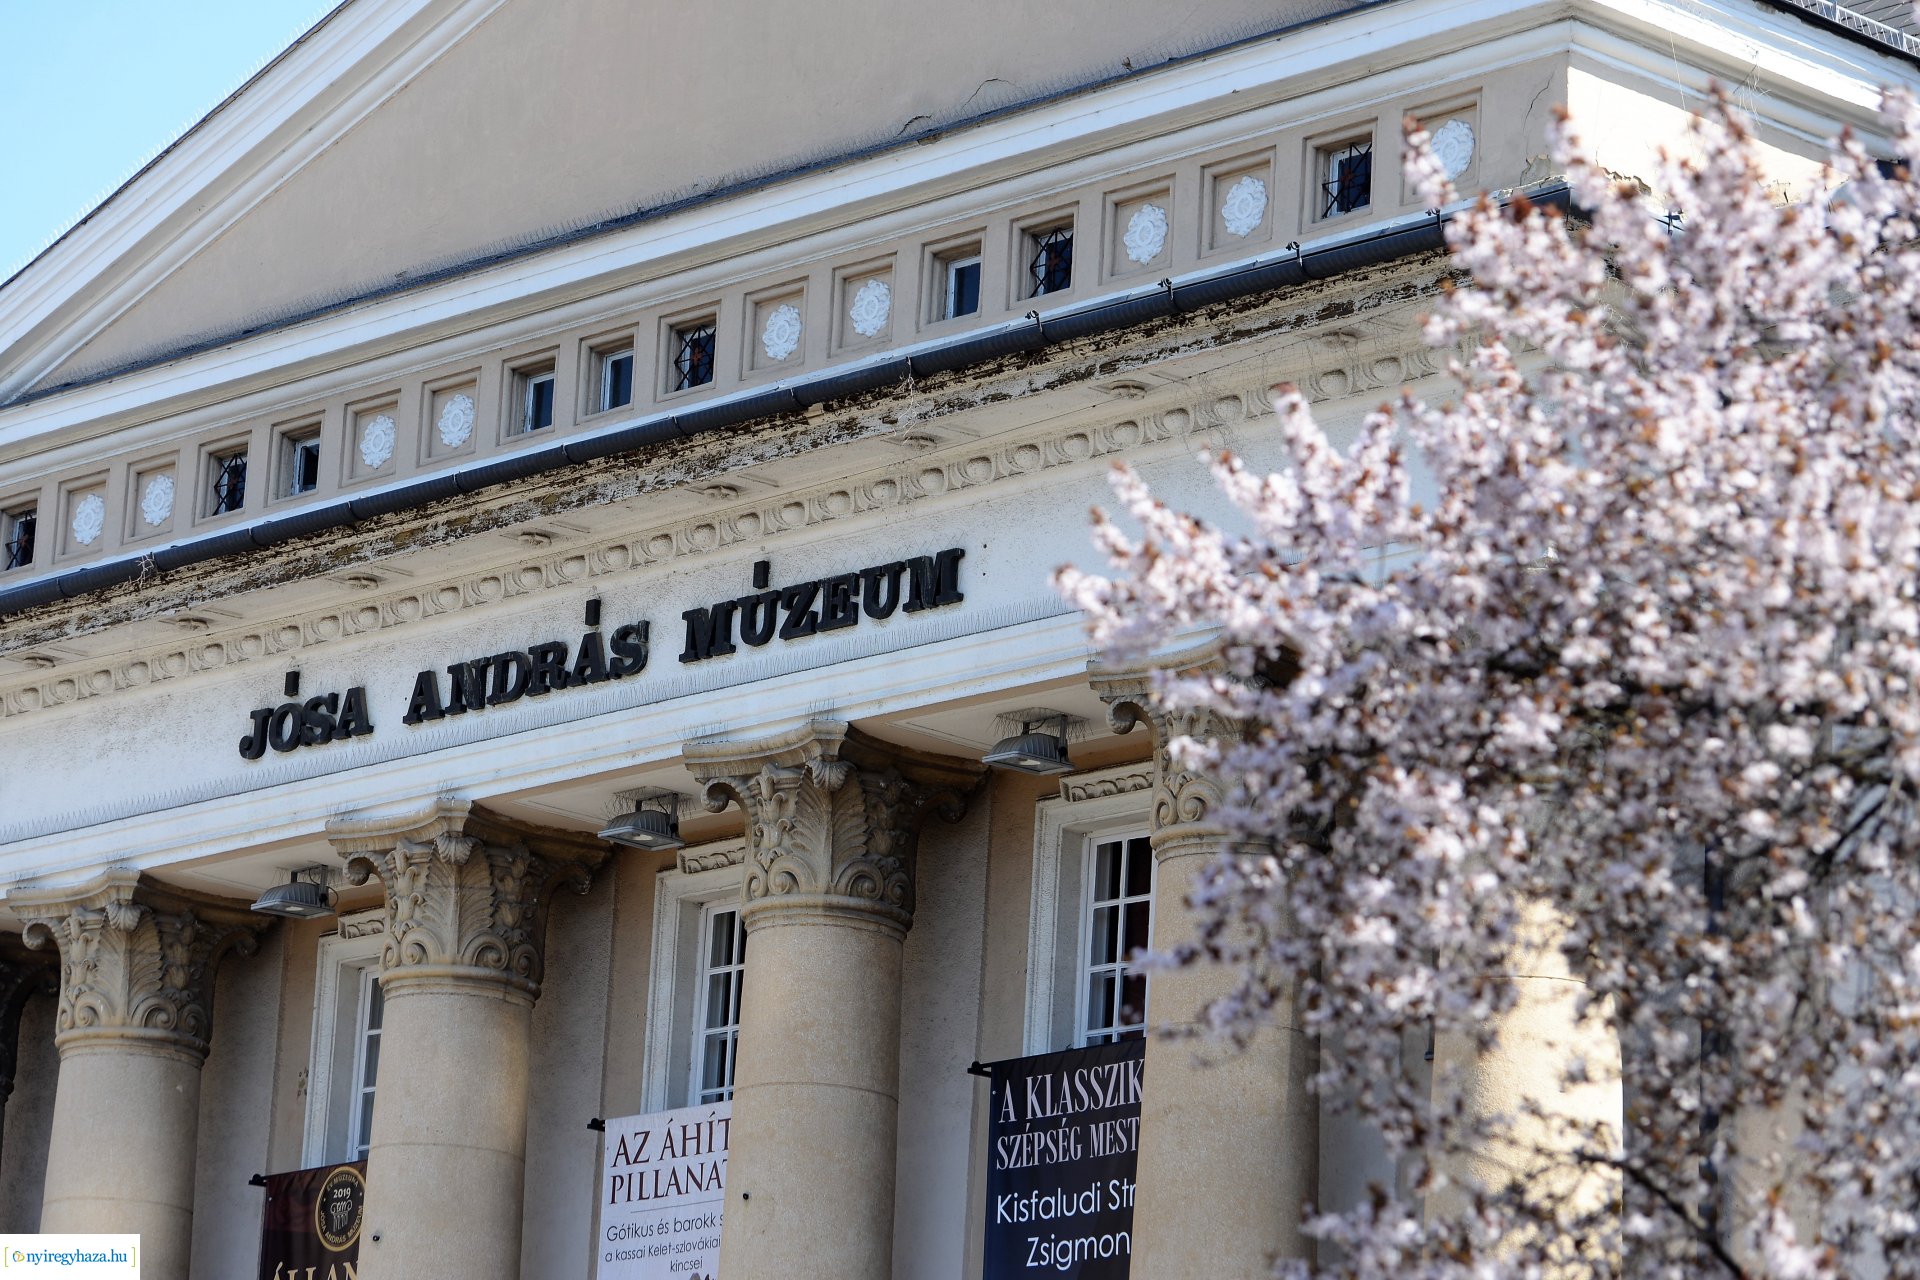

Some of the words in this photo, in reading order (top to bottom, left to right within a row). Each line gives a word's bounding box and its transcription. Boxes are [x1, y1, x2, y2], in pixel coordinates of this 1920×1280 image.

[238, 671, 374, 760] JÓSA
[402, 598, 650, 726] ANDRÁS
[677, 547, 966, 664] MÚZEUM
[998, 1079, 1017, 1124] A
[1025, 1059, 1144, 1120] KLASSZIK
[610, 1130, 651, 1168] AZ
[657, 1111, 731, 1162] ÁHÍT
[996, 1118, 1082, 1170] SZÉPSÉG
[1089, 1116, 1140, 1159] MEST
[333, 1187, 352, 1200] 2019
[609, 1158, 727, 1205] PILLANA
[996, 1181, 1101, 1224] Kisfaludi
[1108, 1178, 1136, 1211] Str
[605, 1252, 613, 1262] a
[615, 1245, 646, 1261] kassai
[648, 1234, 721, 1257] Kelet-szlovákiai
[606, 1223, 654, 1242] Gótikus
[657, 1218, 670, 1234] és
[674, 1212, 716, 1233] barokk
[670, 1256, 703, 1273] kincsei
[1026, 1231, 1131, 1271] Zsigmon
